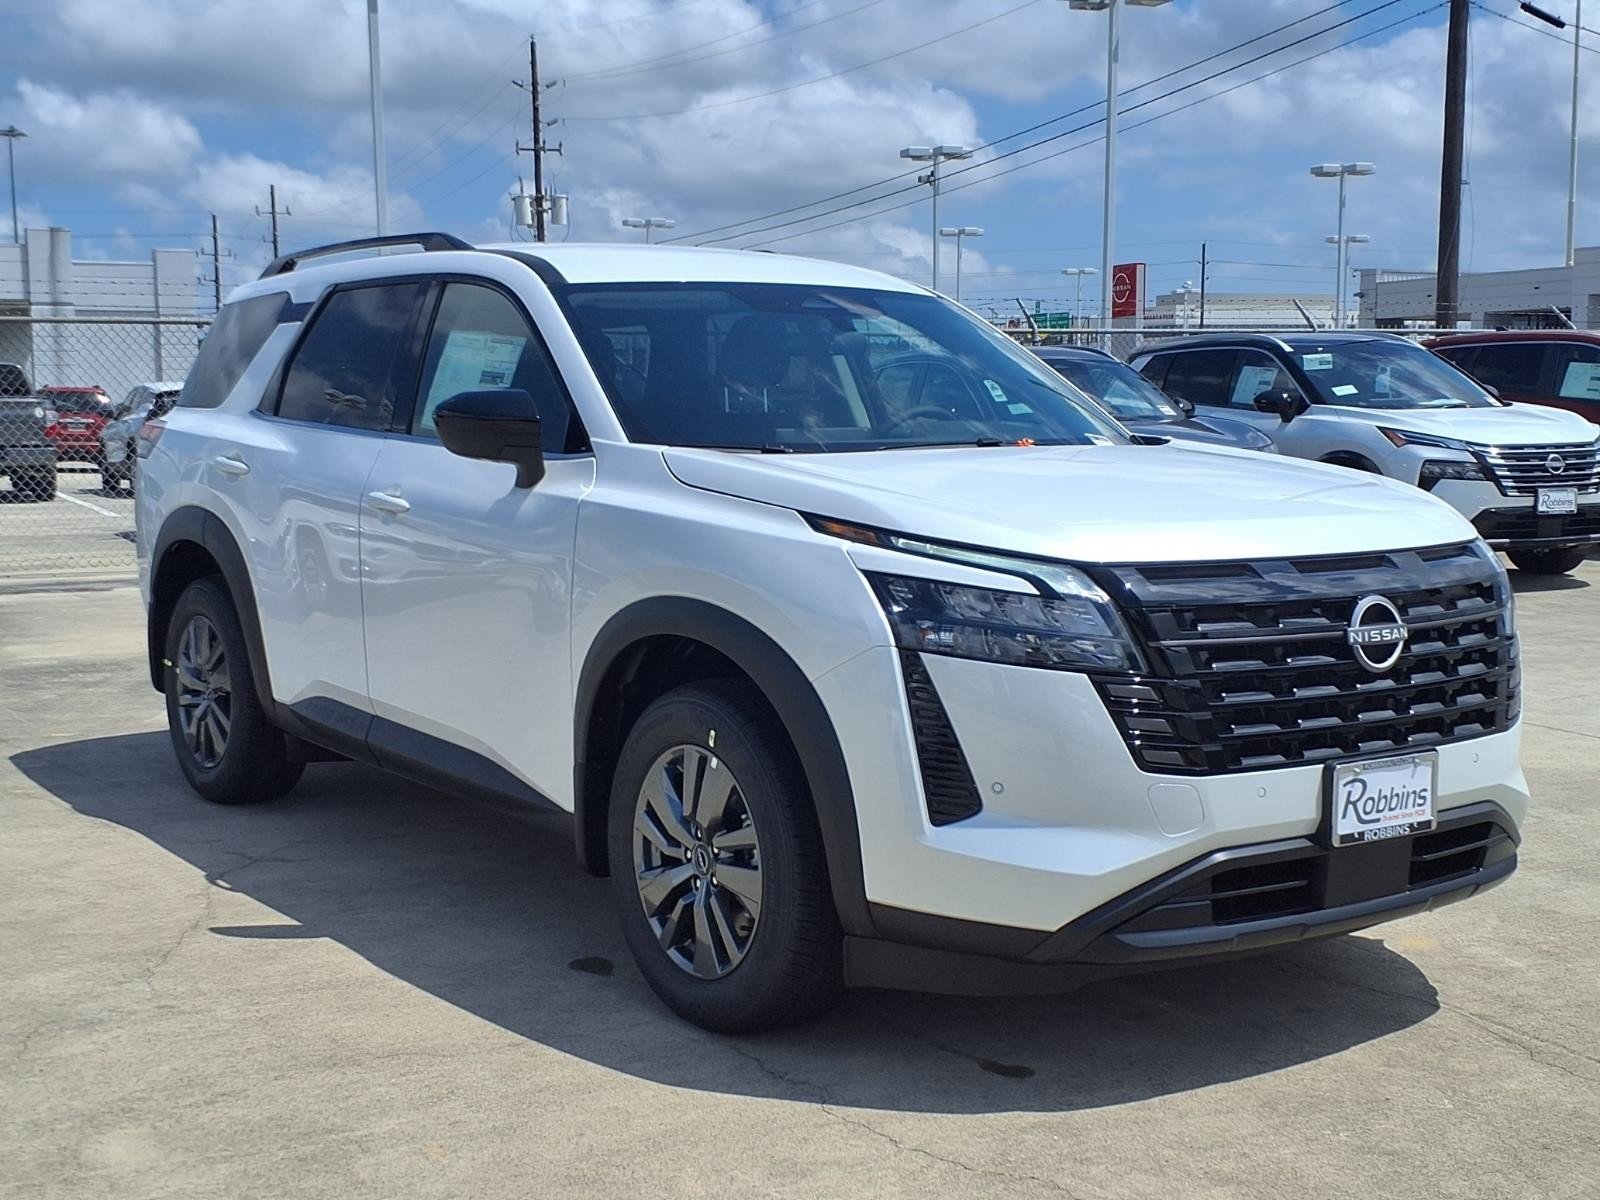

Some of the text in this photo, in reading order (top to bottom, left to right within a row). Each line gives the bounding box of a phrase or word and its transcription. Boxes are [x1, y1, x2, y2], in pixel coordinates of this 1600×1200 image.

[1541, 493, 1574, 509] Robbins
[1350, 627, 1408, 642] NISSAN
[1342, 778, 1428, 824] Robbins
[1364, 824, 1410, 840] ROBBINS
